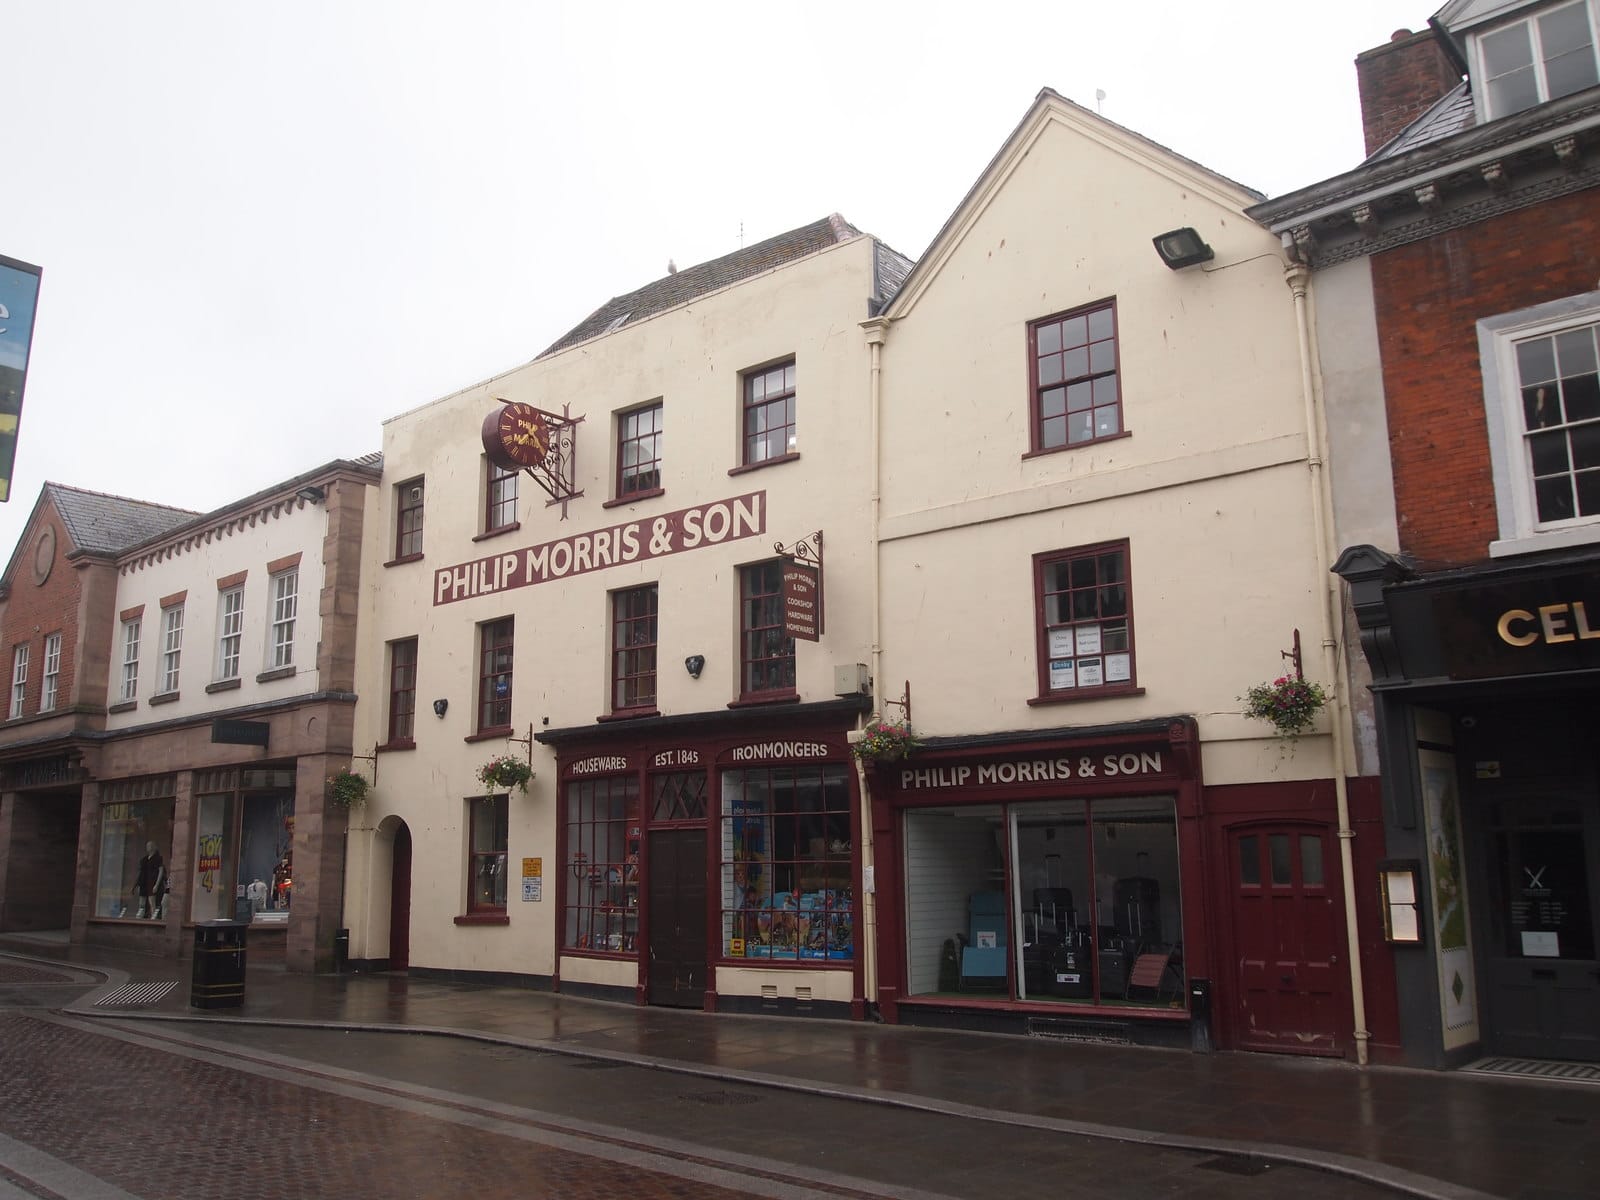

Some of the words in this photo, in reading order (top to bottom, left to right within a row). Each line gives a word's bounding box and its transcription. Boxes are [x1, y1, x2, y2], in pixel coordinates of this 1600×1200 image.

[437, 554, 518, 603] PHILIP
[526, 523, 640, 583] MORRIS
[649, 517, 673, 555] &
[683, 495, 760, 548] SON
[784, 573, 797, 581] PHILIP
[797, 584, 807, 592] SON
[787, 597, 813, 608] COOKSHOP
[788, 611, 812, 622] HARDWARE
[1497, 601, 1600, 646] CEL
[787, 623, 814, 635] HOMEWARES
[655, 750, 674, 766] EST.
[677, 750, 699, 765] 1845
[733, 742, 828, 761] IRONMONGERS
[572, 756, 627, 775] HOUSEWARES
[901, 766, 972, 789] PHILIP
[977, 758, 1071, 785] MORRIS
[1078, 756, 1097, 778] &
[1103, 752, 1162, 776] SON
[200, 835, 222, 856] TOY
[202, 869, 213, 891] 4
